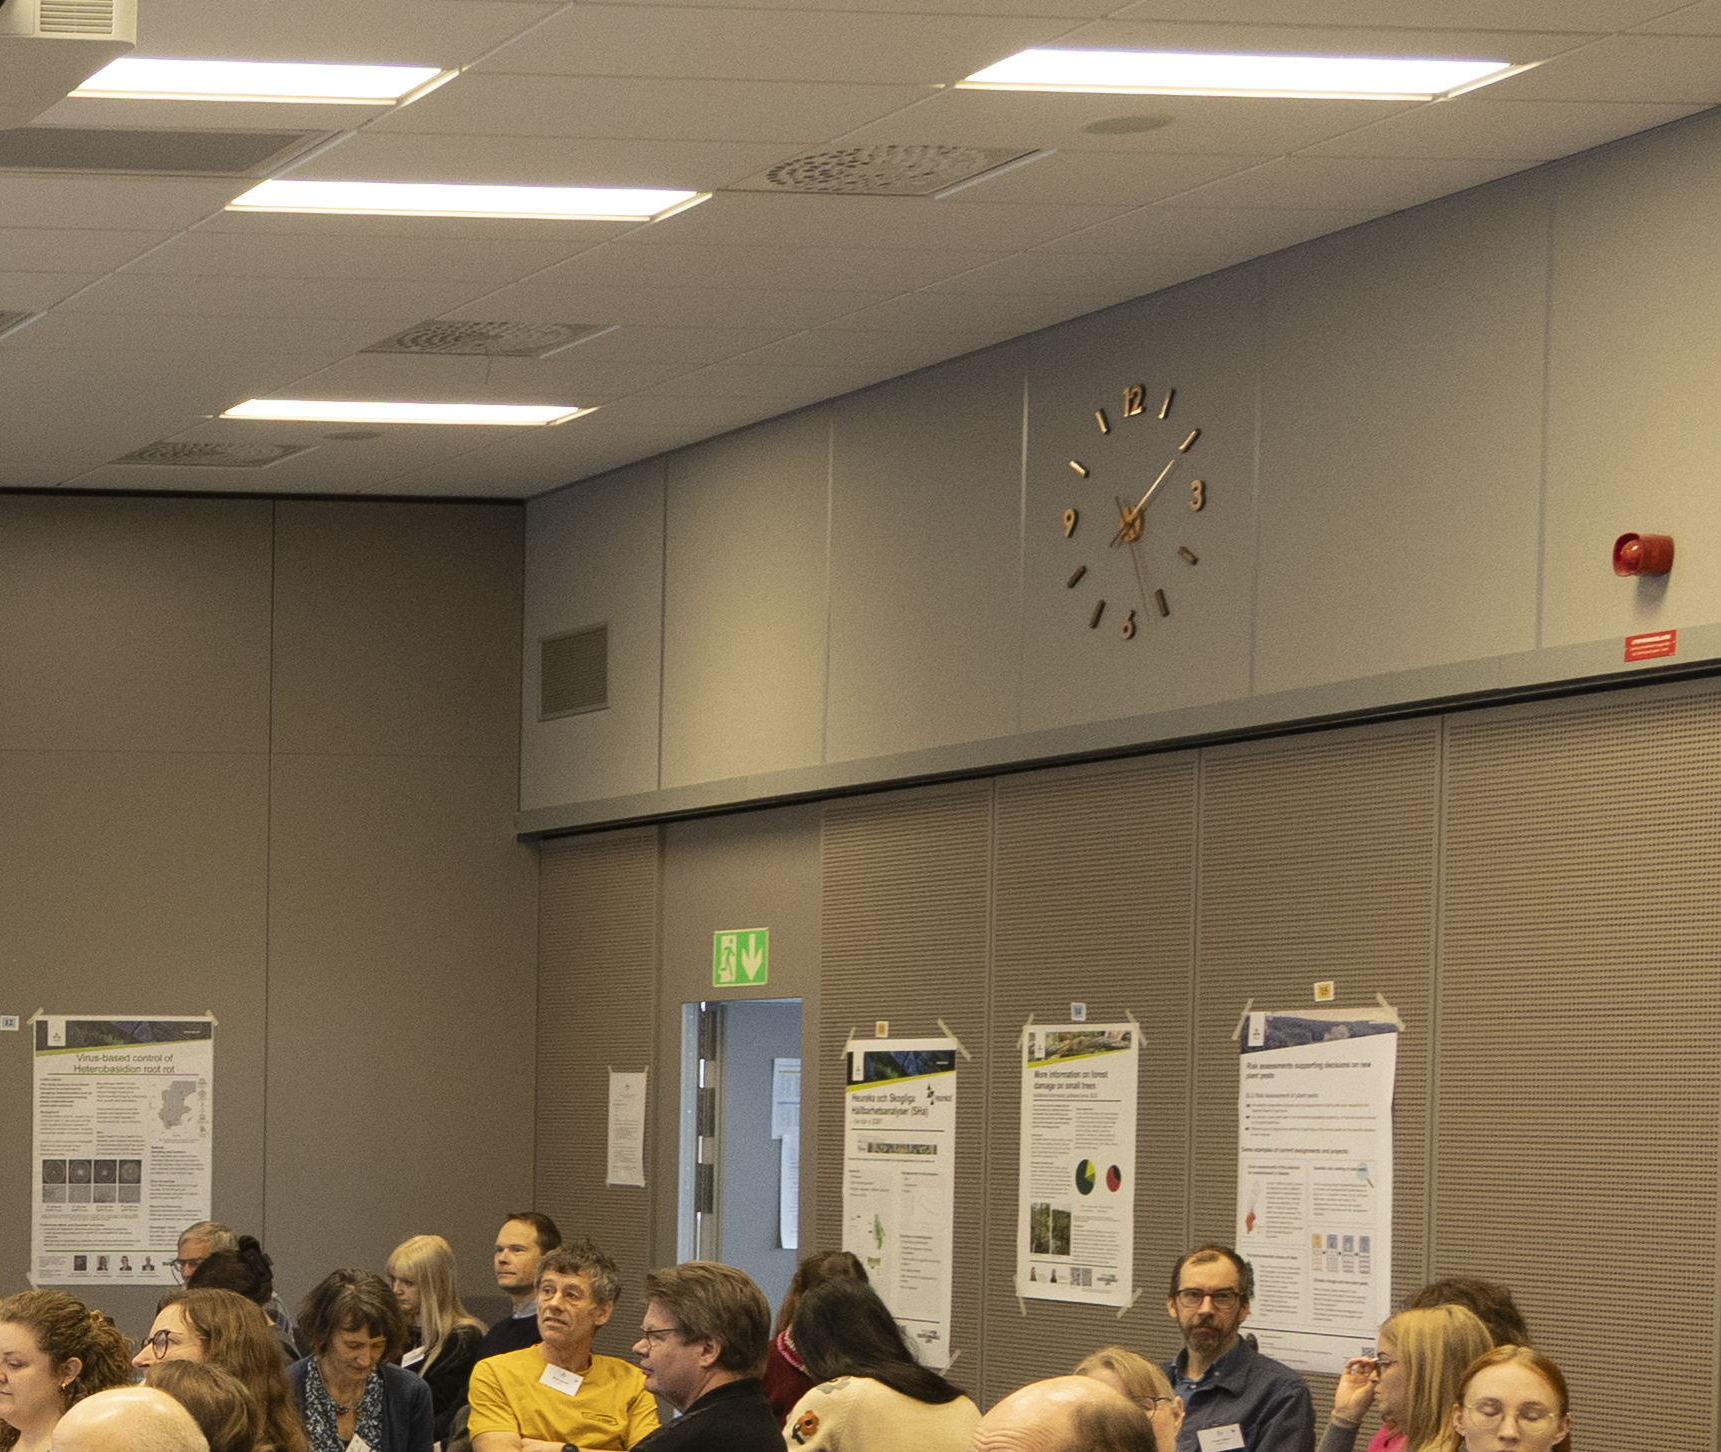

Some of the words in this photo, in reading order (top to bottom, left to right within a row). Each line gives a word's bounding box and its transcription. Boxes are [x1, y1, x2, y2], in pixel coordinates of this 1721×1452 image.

[1123, 386, 1143, 417] 12
[1190, 480, 1205, 511] 3
[1063, 508, 1078, 538] 9
[1122, 609, 1136, 640] 6
[5, 1019, 14, 1027] 12
[76, 1053, 130, 1062] Virus-based
[133, 1054, 163, 1062] control
[164, 1053, 174, 1062] of
[73, 1065, 141, 1073] Heterobasidion
[143, 1065, 160, 1073] root
[162, 1065, 175, 1073] rot
[1294, 1062, 1323, 1070] supporting
[1324, 1061, 1350, 1069] decisions
[1034, 1070, 1047, 1078] More
[1049, 1070, 1080, 1078] information
[1091, 1070, 1108, 1078] forest
[1246, 1072, 1258, 1080] plant
[1033, 1082, 1055, 1091] damage
[852, 1094, 875, 1102] Heureka
[877, 1094, 888, 1102] och
[889, 1093, 915, 1104] Skogliga
